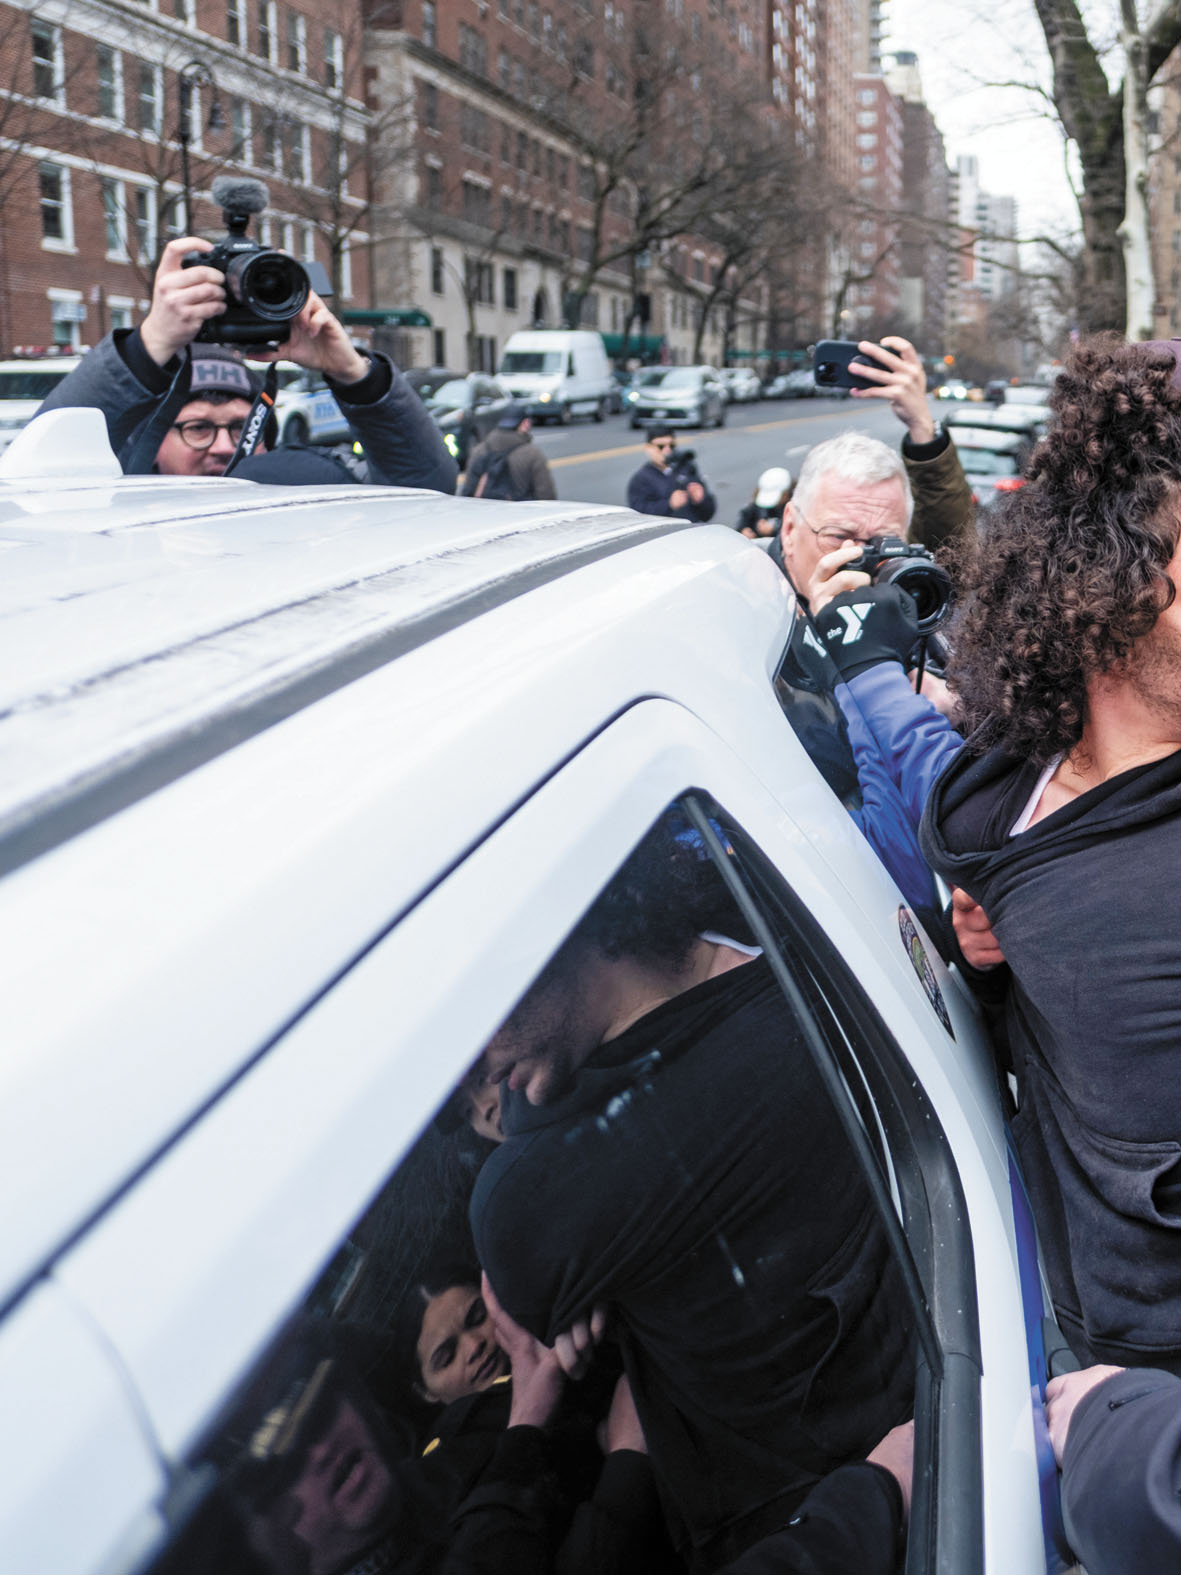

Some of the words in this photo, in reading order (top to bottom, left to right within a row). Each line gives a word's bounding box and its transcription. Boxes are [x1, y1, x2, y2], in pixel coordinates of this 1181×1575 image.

[195, 364, 242, 384] HH
[242, 405, 268, 456] SONY
[827, 627, 842, 640] the
[836, 602, 872, 645] Y
